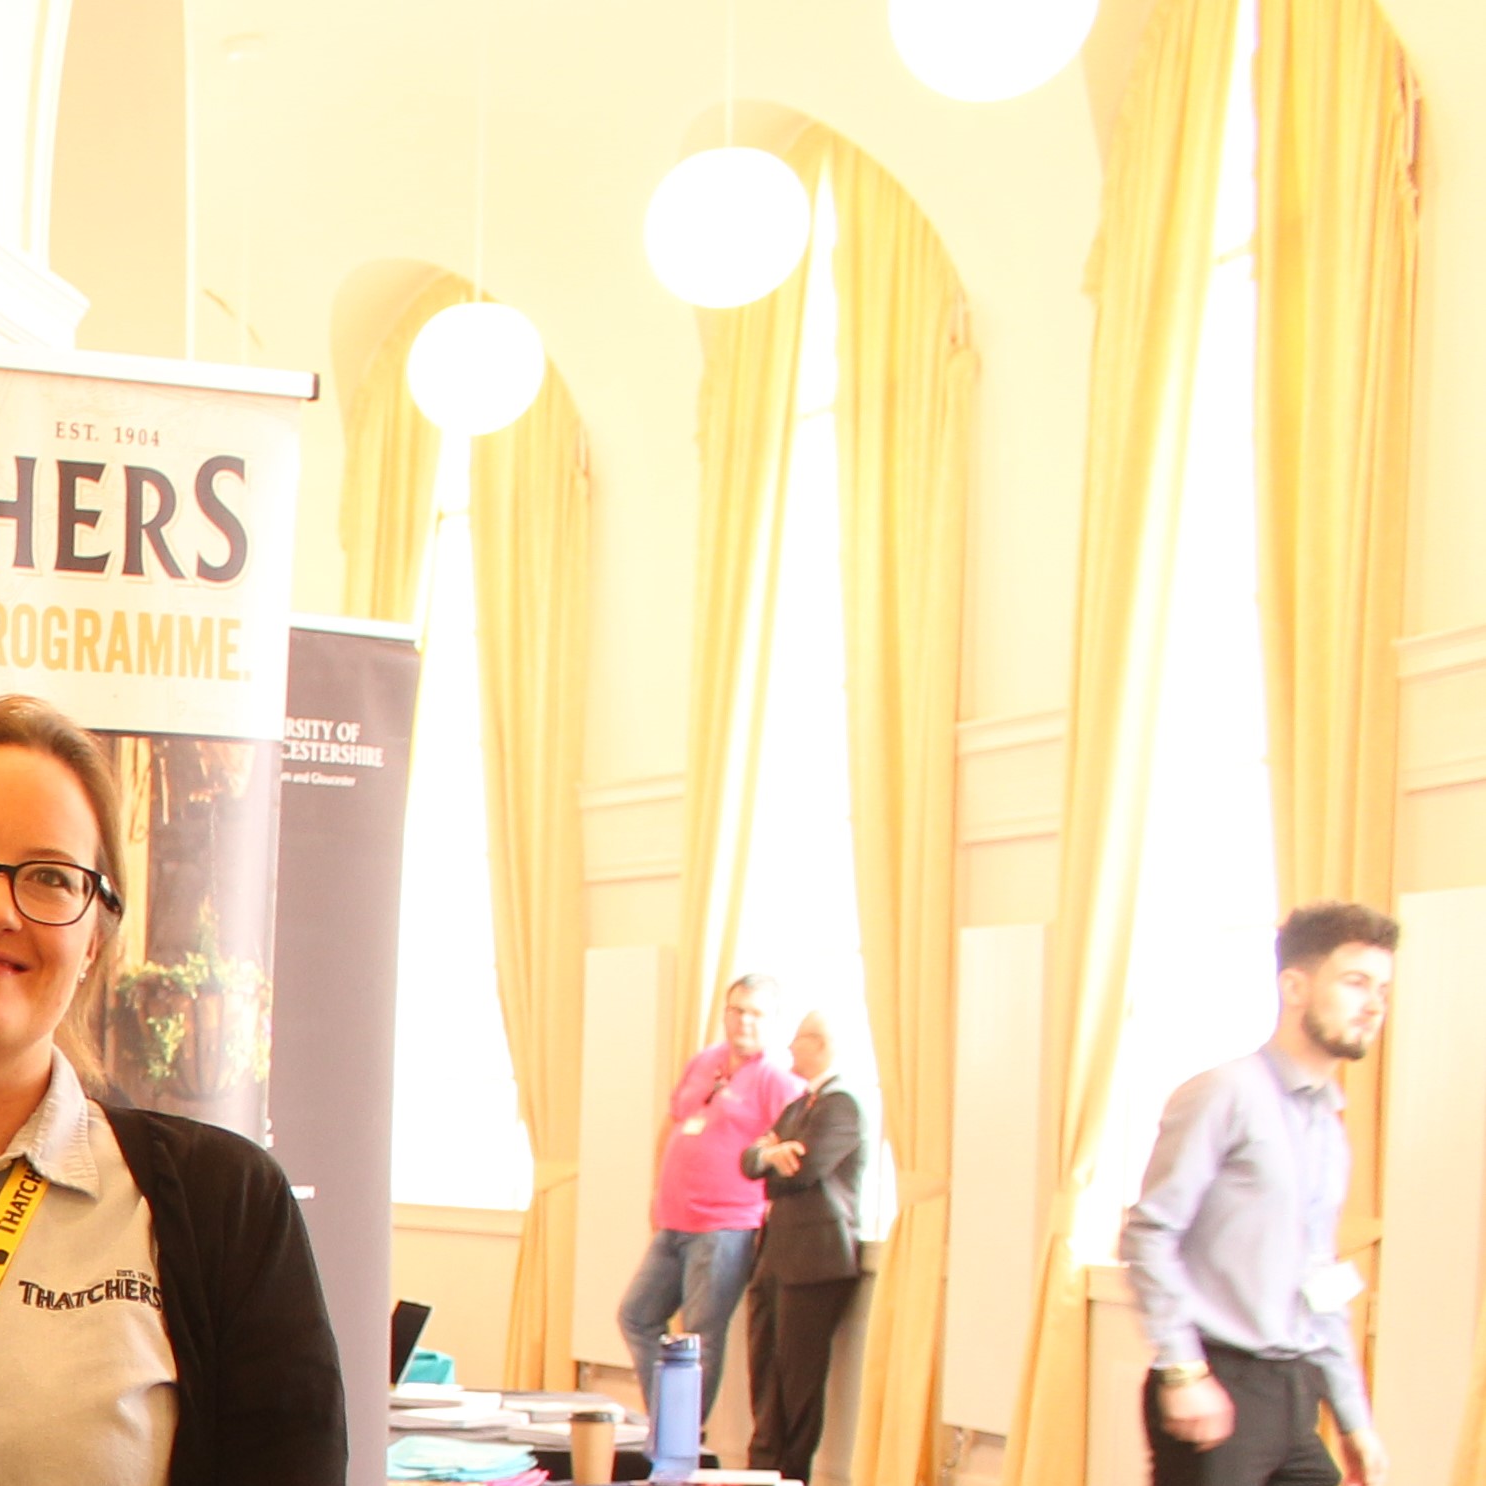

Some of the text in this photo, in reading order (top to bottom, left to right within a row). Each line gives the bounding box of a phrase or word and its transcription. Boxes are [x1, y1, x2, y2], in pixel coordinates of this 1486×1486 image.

[54, 421, 162, 448] EST. 1904
[336, 720, 361, 743] OF
[18, 1279, 163, 1311] THATCHERS
